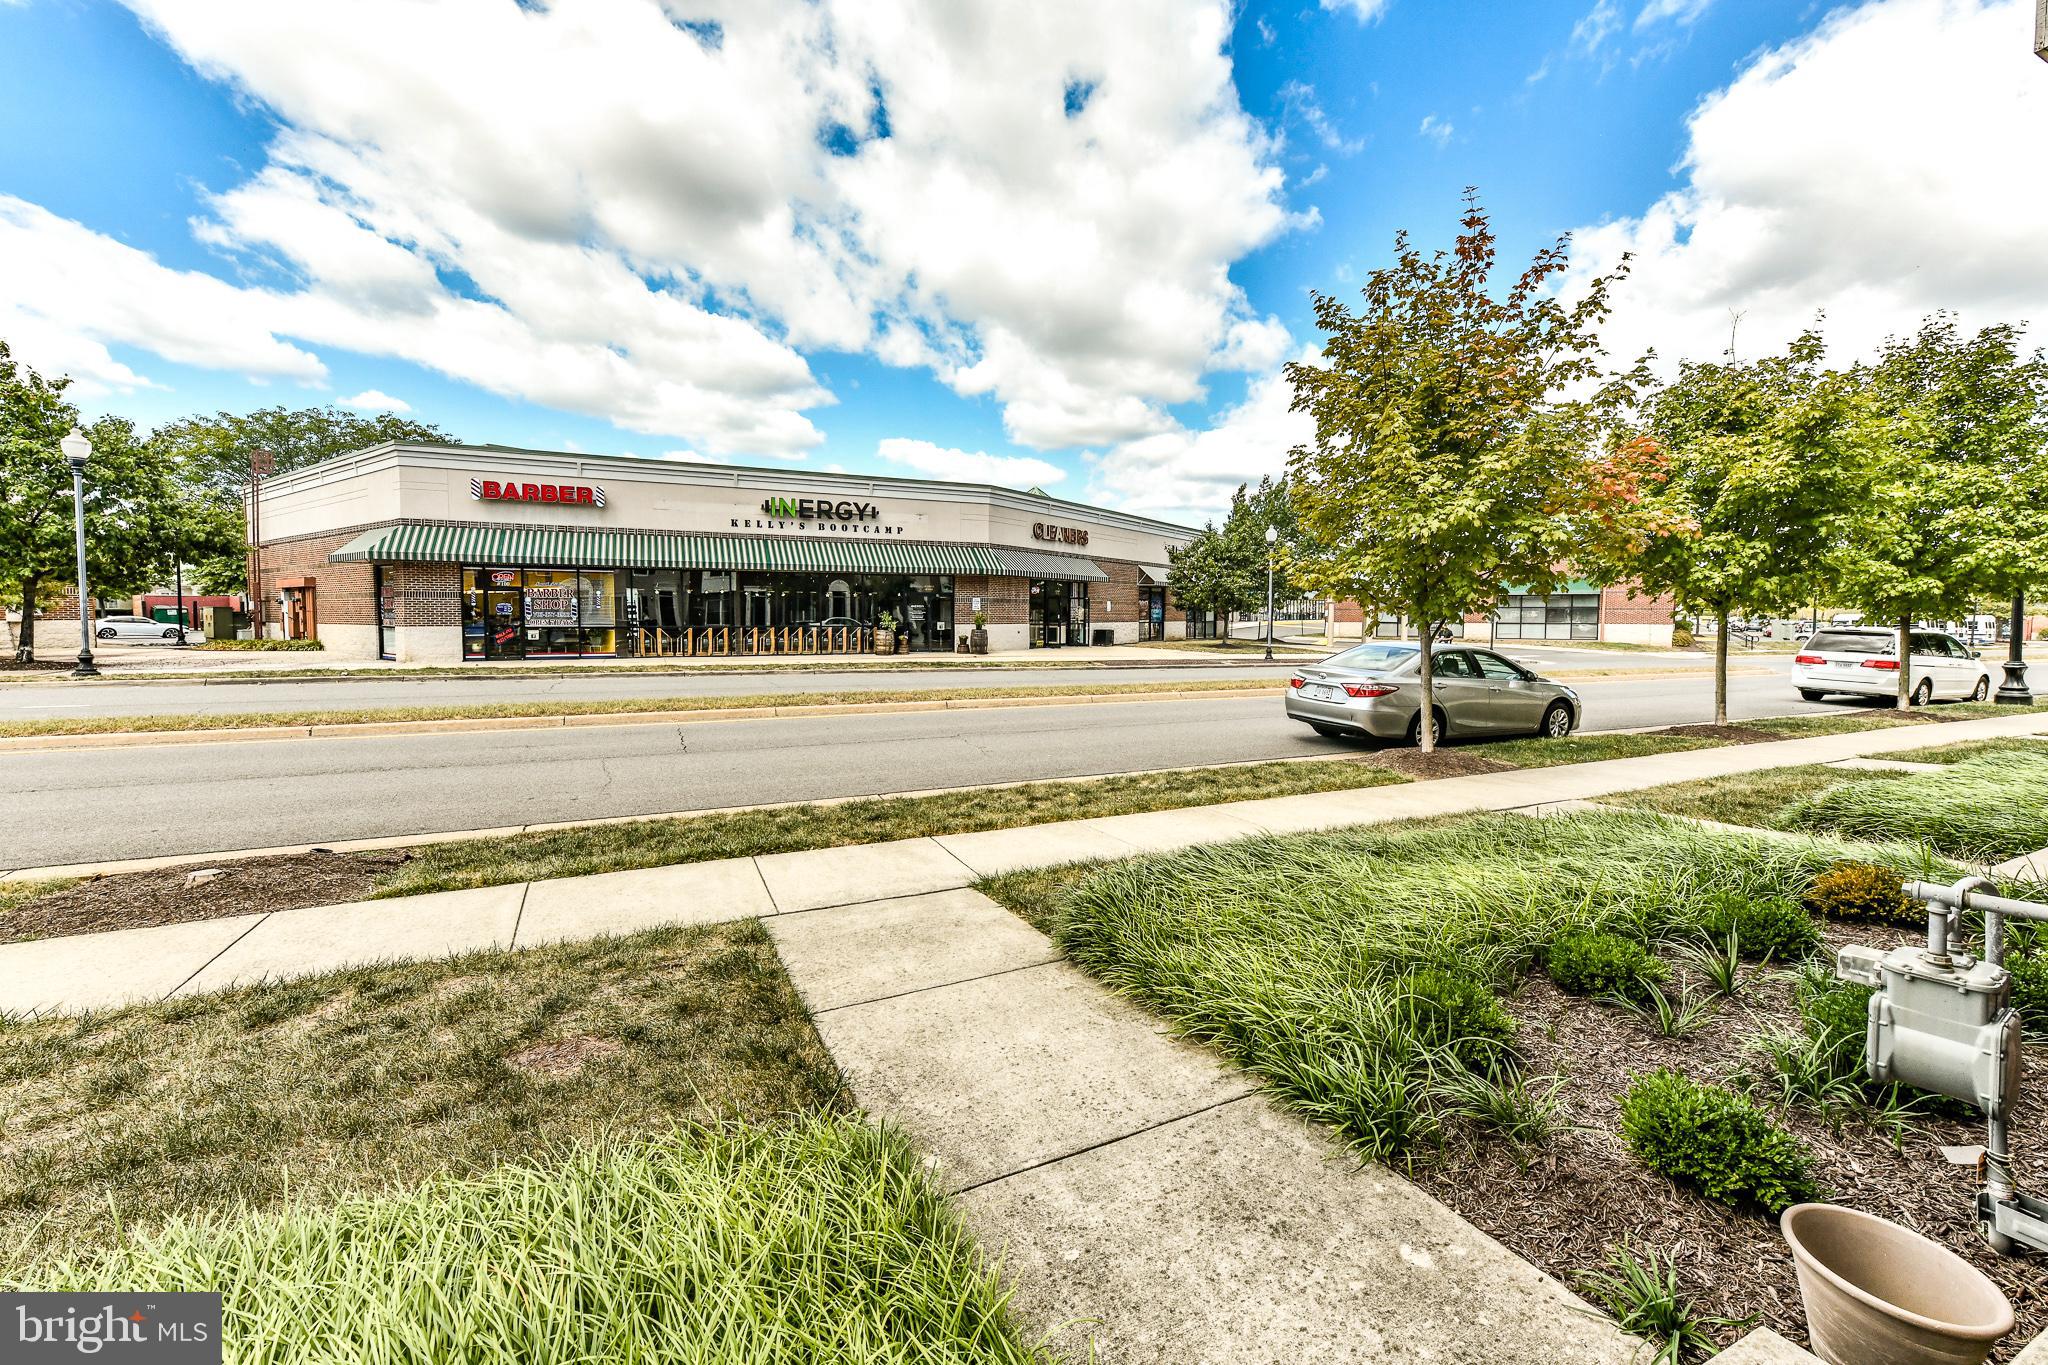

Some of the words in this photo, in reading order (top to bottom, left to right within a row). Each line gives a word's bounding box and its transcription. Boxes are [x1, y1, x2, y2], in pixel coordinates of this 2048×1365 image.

[482, 480, 593, 505] BARBER
[770, 496, 870, 521] INERGY
[731, 519, 805, 531] KELLY'S
[818, 523, 904, 535] BOOTCAMP
[1033, 522, 1089, 546] CLEANERS
[492, 573, 514, 582] OPEN
[527, 588, 574, 598] BARBER
[534, 599, 568, 610] SHOP
